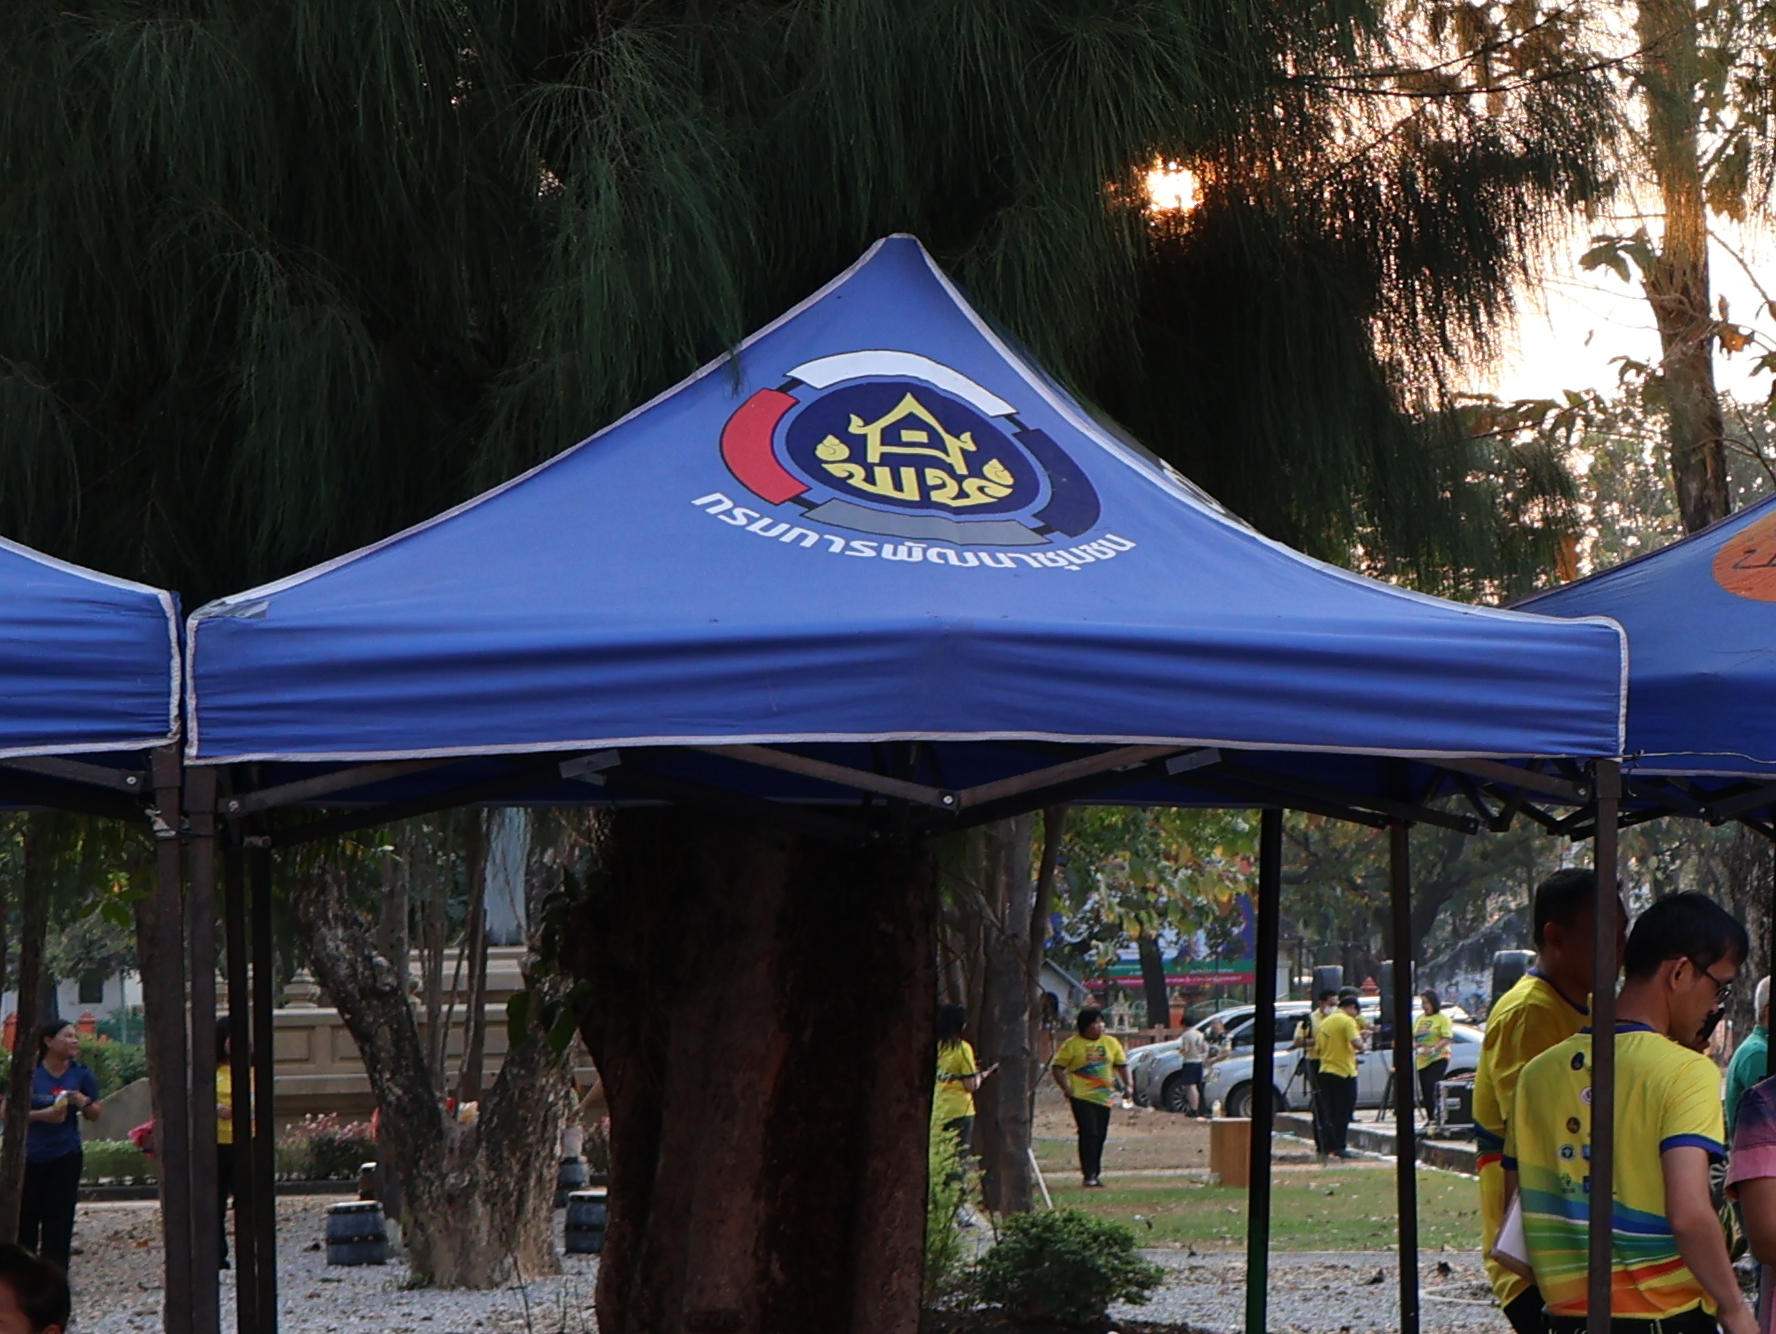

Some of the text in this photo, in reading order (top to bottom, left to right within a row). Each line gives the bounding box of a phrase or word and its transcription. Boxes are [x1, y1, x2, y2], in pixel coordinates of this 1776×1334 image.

[691, 492, 1137, 571] กรมการพัฒนาชุมชน
